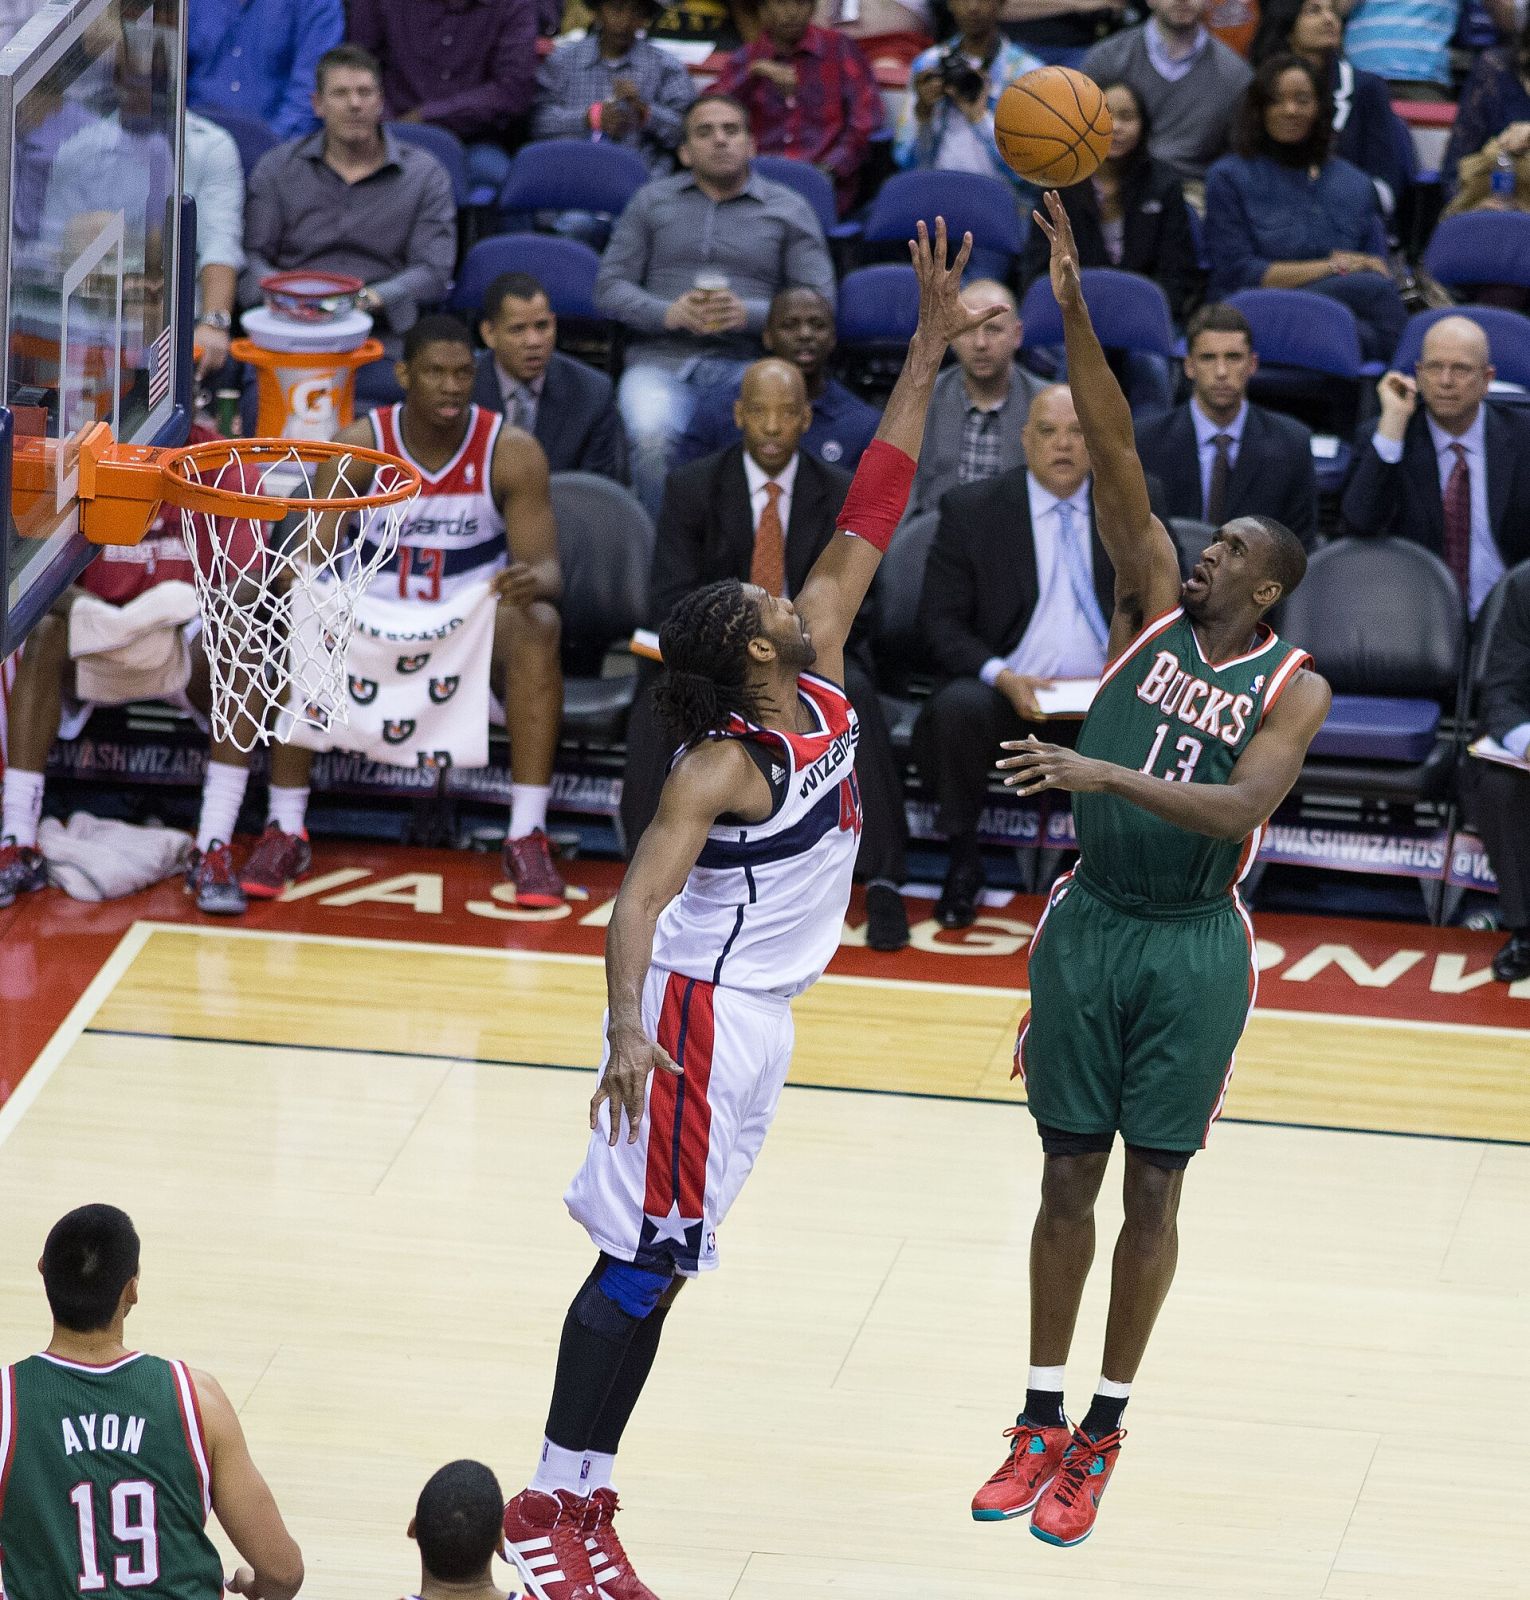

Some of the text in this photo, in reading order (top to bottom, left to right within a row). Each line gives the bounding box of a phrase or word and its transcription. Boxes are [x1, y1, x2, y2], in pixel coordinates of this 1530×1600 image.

[397, 544, 445, 602] 13
[1136, 650, 1254, 746] BUCKS
[1139, 723, 1203, 782] 13
[62, 1413, 146, 1456] AYON
[69, 1478, 160, 1592] 19
